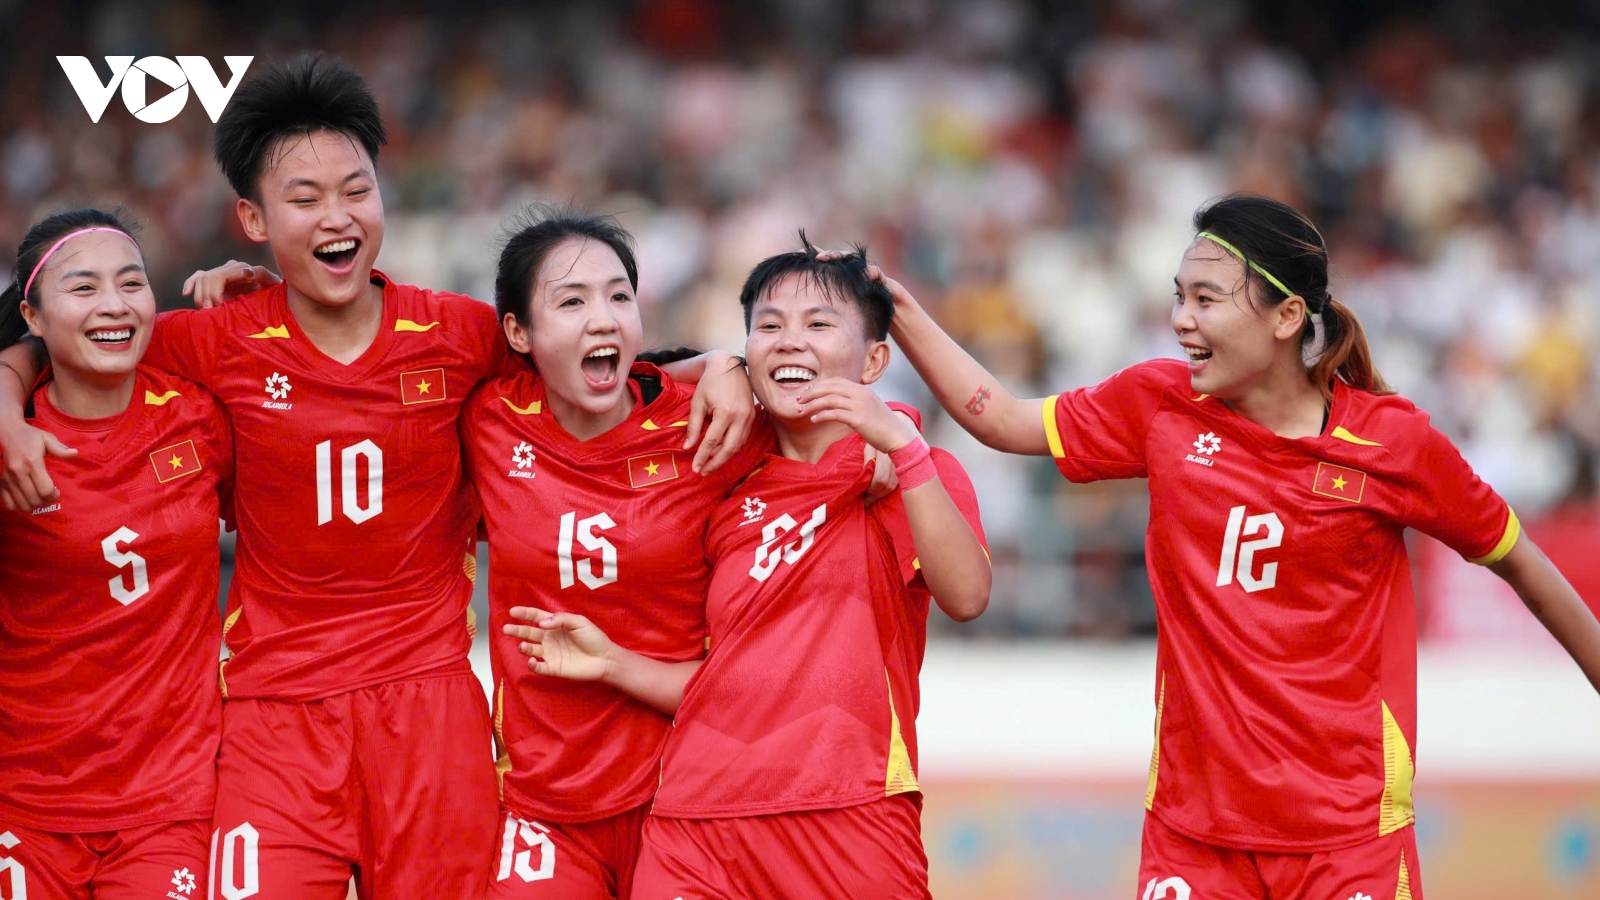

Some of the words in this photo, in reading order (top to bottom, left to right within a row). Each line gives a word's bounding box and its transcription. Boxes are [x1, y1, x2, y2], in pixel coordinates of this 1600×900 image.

[316, 438, 383, 526] 10
[101, 525, 150, 606] 5
[557, 511, 618, 590] 15
[1216, 505, 1285, 593] 12
[496, 811, 556, 883] 15
